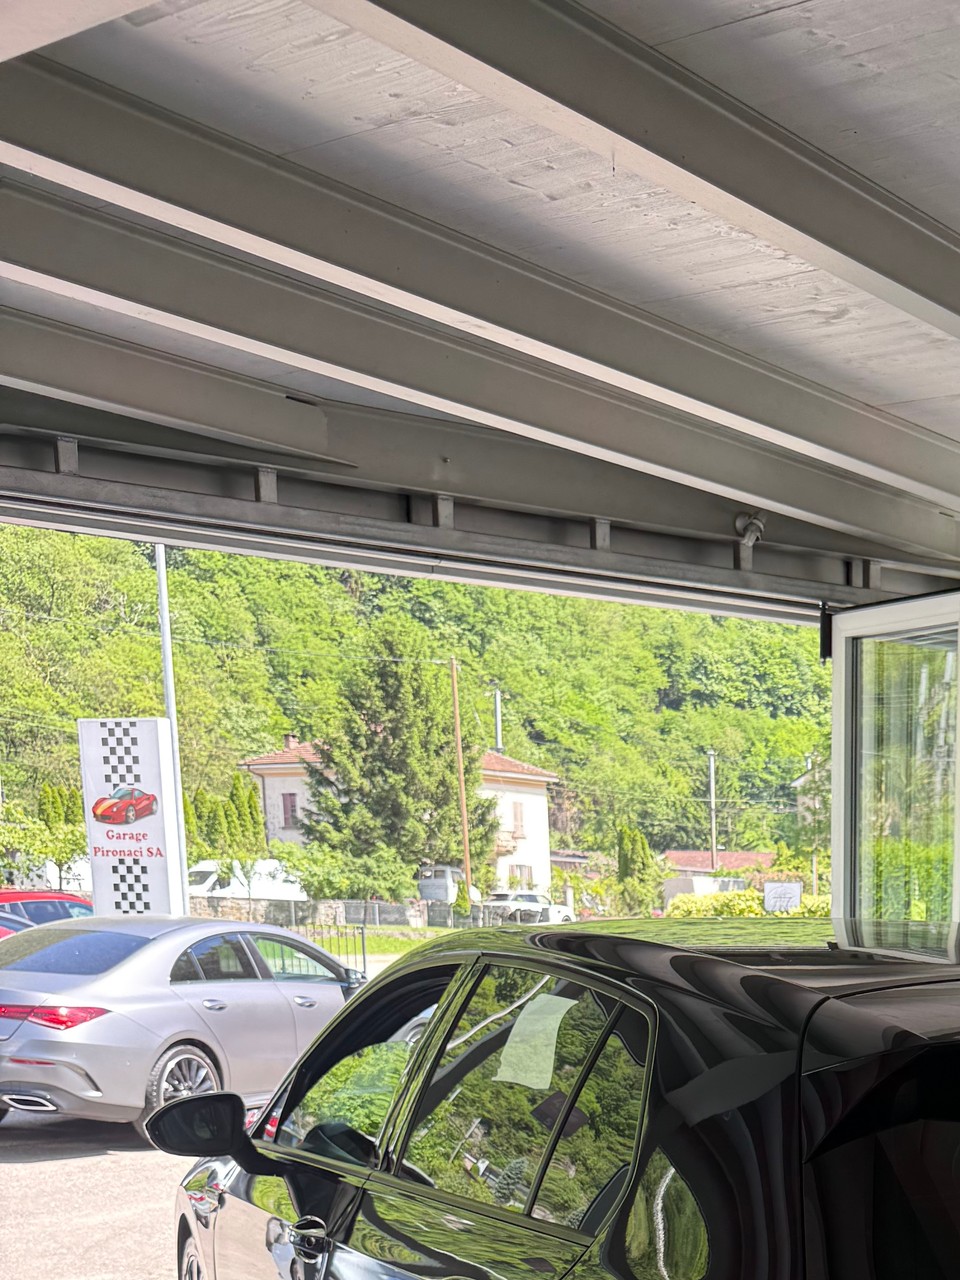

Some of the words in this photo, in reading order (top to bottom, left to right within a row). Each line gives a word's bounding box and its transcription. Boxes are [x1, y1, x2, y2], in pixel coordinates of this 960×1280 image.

[106, 829, 149, 843] Garage
[93, 846, 143, 858] Pironaci
[146, 846, 165, 858] SA
